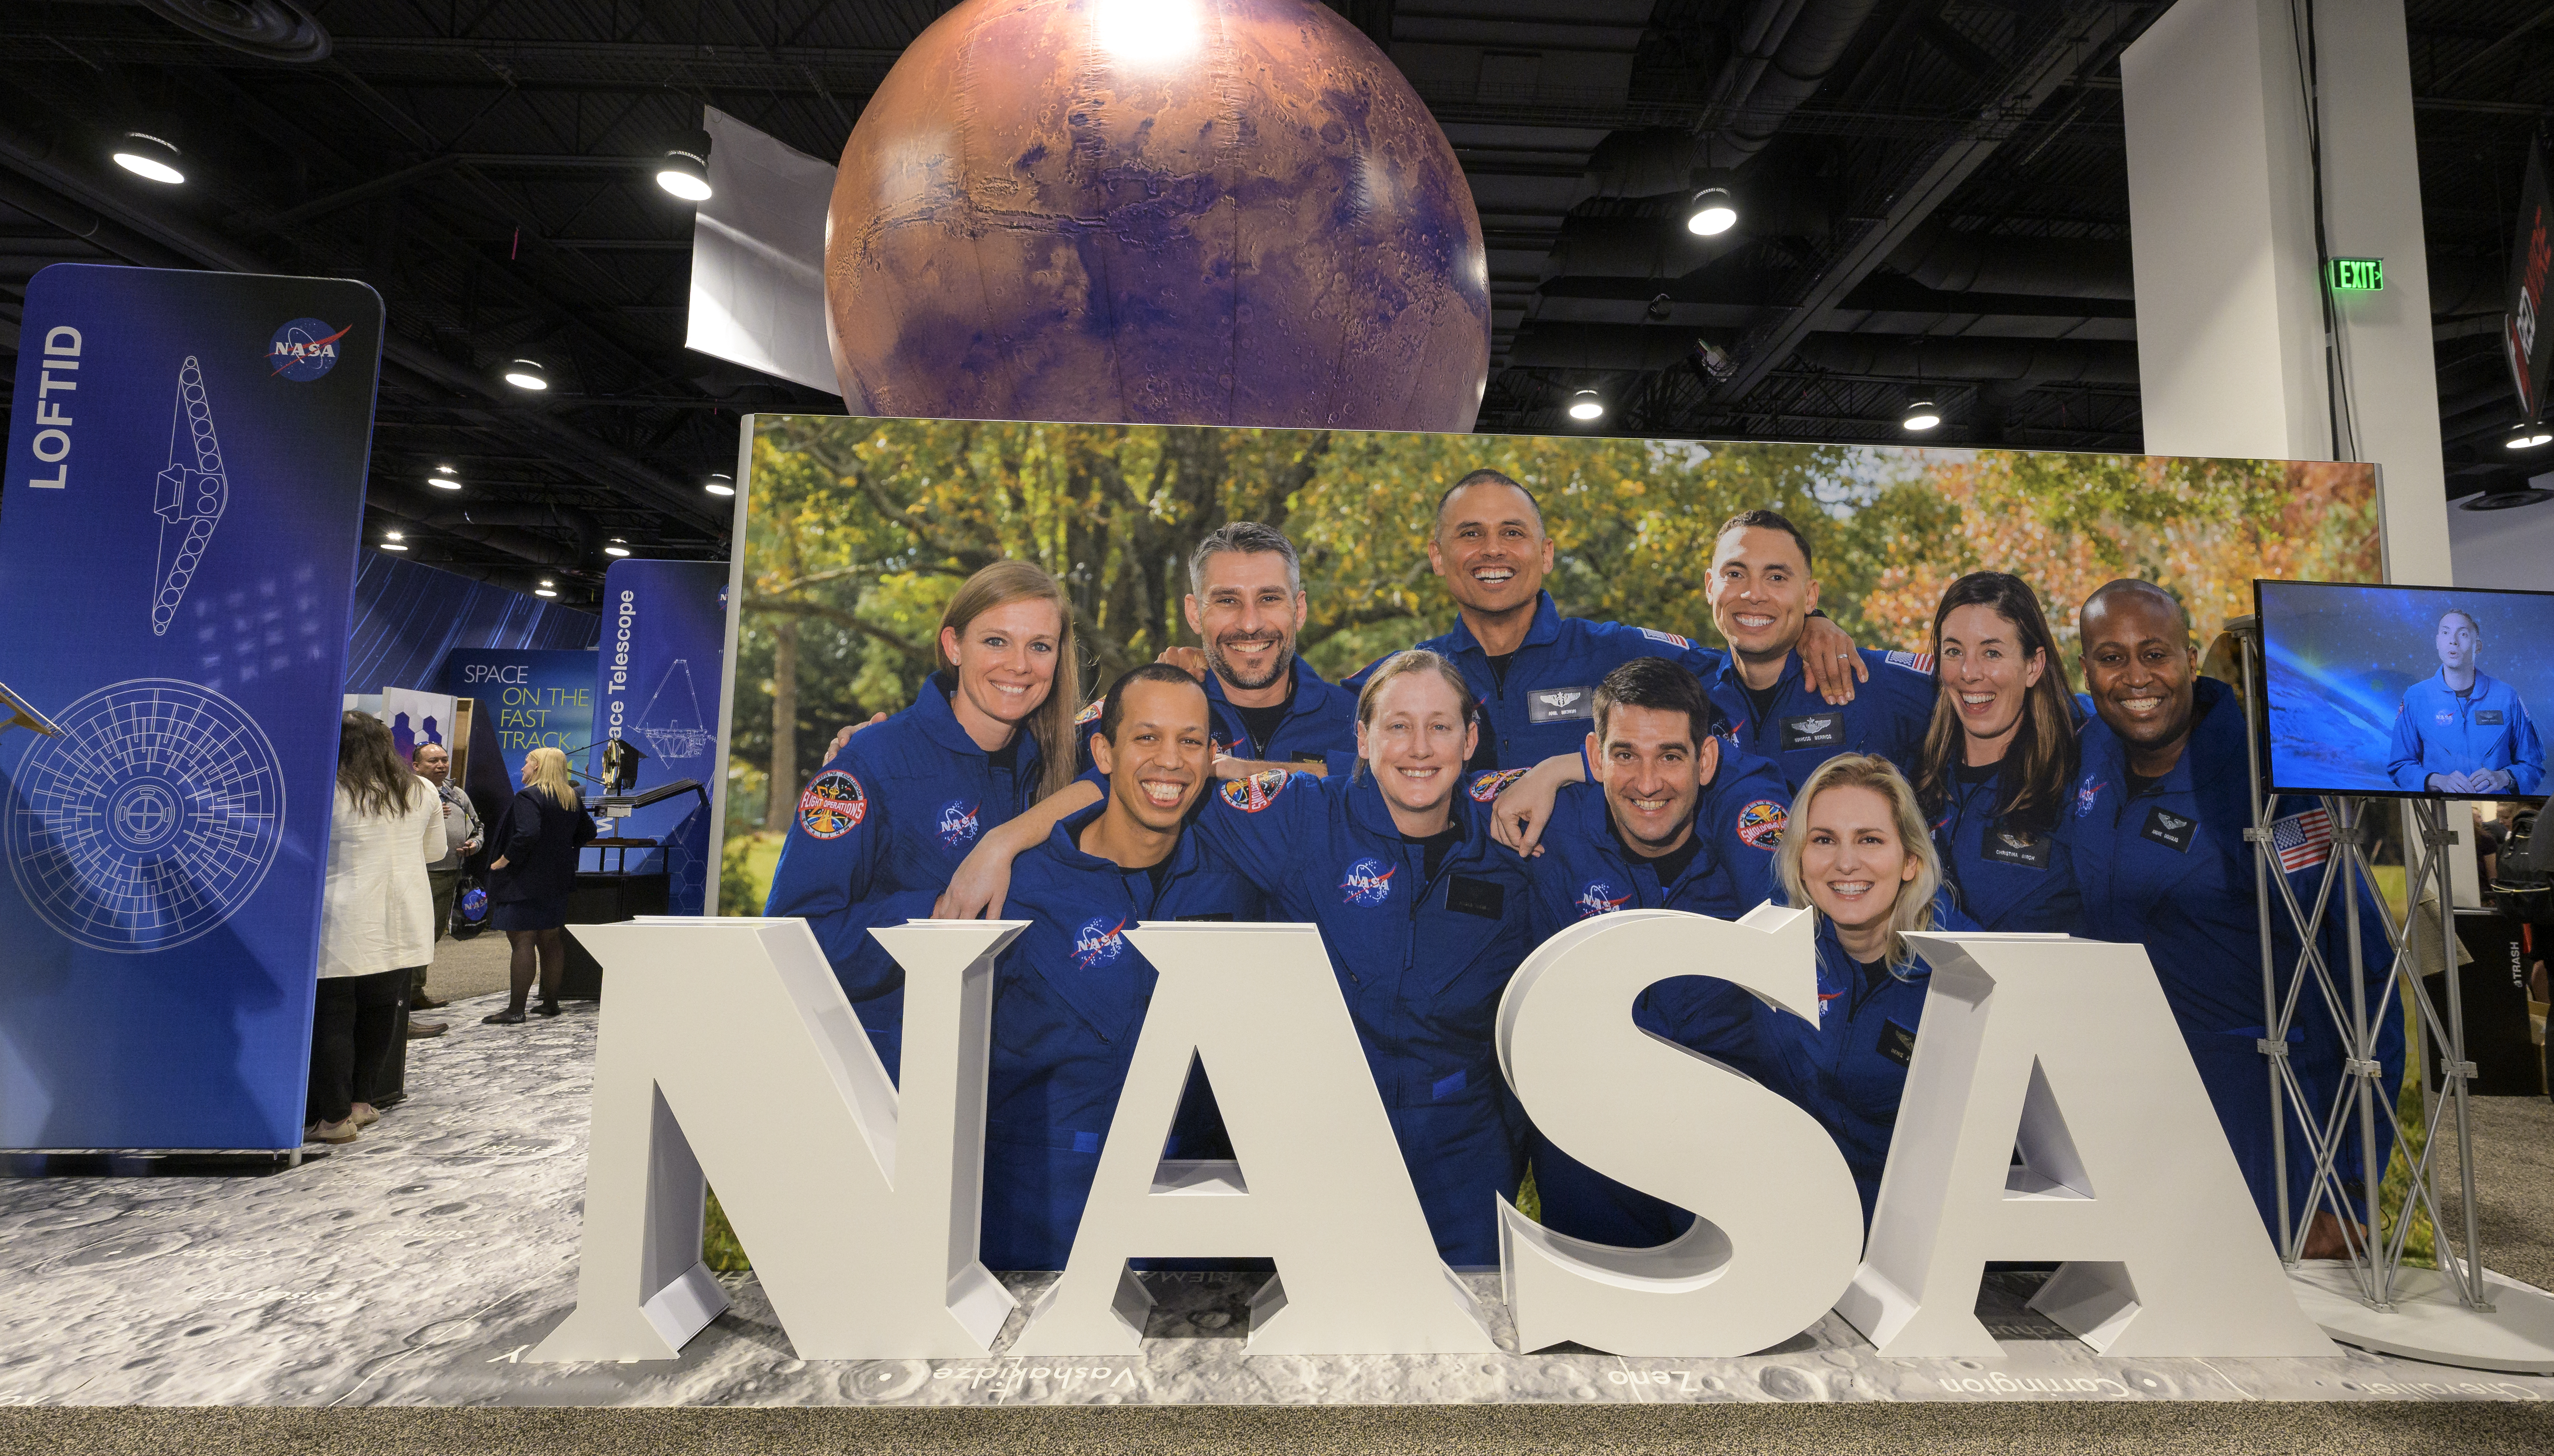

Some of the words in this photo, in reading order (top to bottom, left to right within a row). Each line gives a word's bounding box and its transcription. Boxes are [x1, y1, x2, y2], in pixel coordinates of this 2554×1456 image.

[2340, 261, 2375, 289] EXIT
[274, 342, 336, 358] NASA
[29, 326, 82, 489] LOFTID
[608, 590, 636, 695] Telescope
[464, 666, 528, 683] SPACE
[503, 688, 542, 706] ON
[547, 689, 589, 707] THE
[500, 710, 550, 728] FAST
[608, 700, 625, 739] ace
[499, 731, 576, 750] TRACK.
[800, 791, 823, 808] FLIGHT
[823, 800, 864, 820] OPERATIONS
[941, 816, 980, 834] NASA
[2164, 833, 2179, 843] DOUGLAS
[1996, 849, 2018, 858] CHRISTINA
[1348, 873, 1390, 892] NASA
[1077, 933, 1124, 952] NASA
[2510, 942, 2522, 980] TRASH
[523, 906, 2347, 1363] NASA
[468, 1145, 557, 1153] EYFERT
[365, 1229, 474, 1240] Sumner
[165, 1249, 273, 1260] Cantor
[187, 1284, 334, 1304] Sisakyan
[933, 1365, 1136, 1390] Vashakidze
[1608, 1369, 1698, 1393] Zeno
[1939, 1371, 2130, 1398] Carrington
[2361, 1381, 2541, 1400] Chevallier
